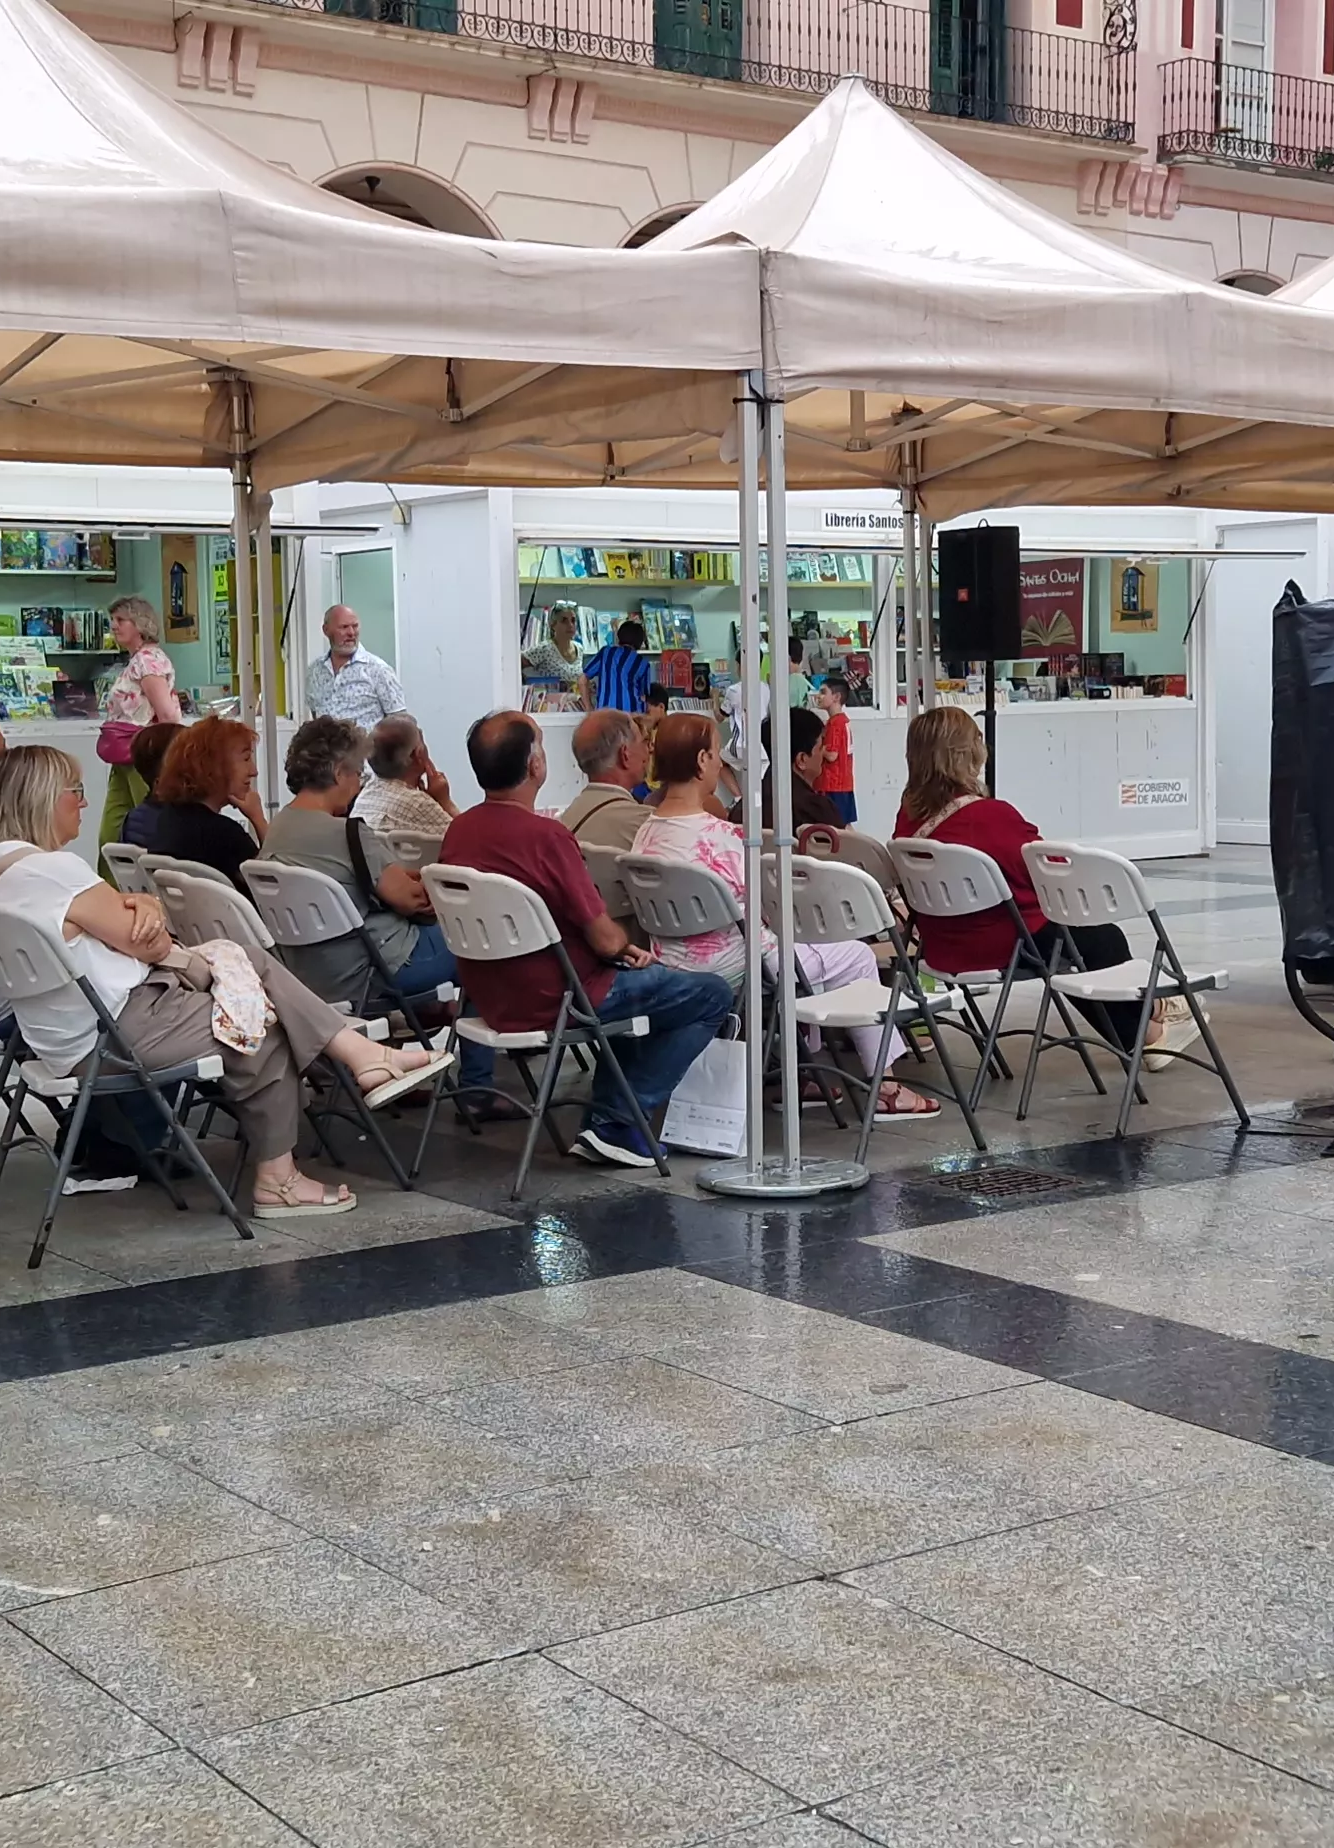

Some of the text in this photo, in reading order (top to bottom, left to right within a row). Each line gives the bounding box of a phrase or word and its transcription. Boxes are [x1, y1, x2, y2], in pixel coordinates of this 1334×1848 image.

[825, 512, 866, 528] Librería
[868, 514, 904, 529] Santos
[1137, 781, 1182, 793] GOBIERNO
[1137, 794, 1149, 804] DE
